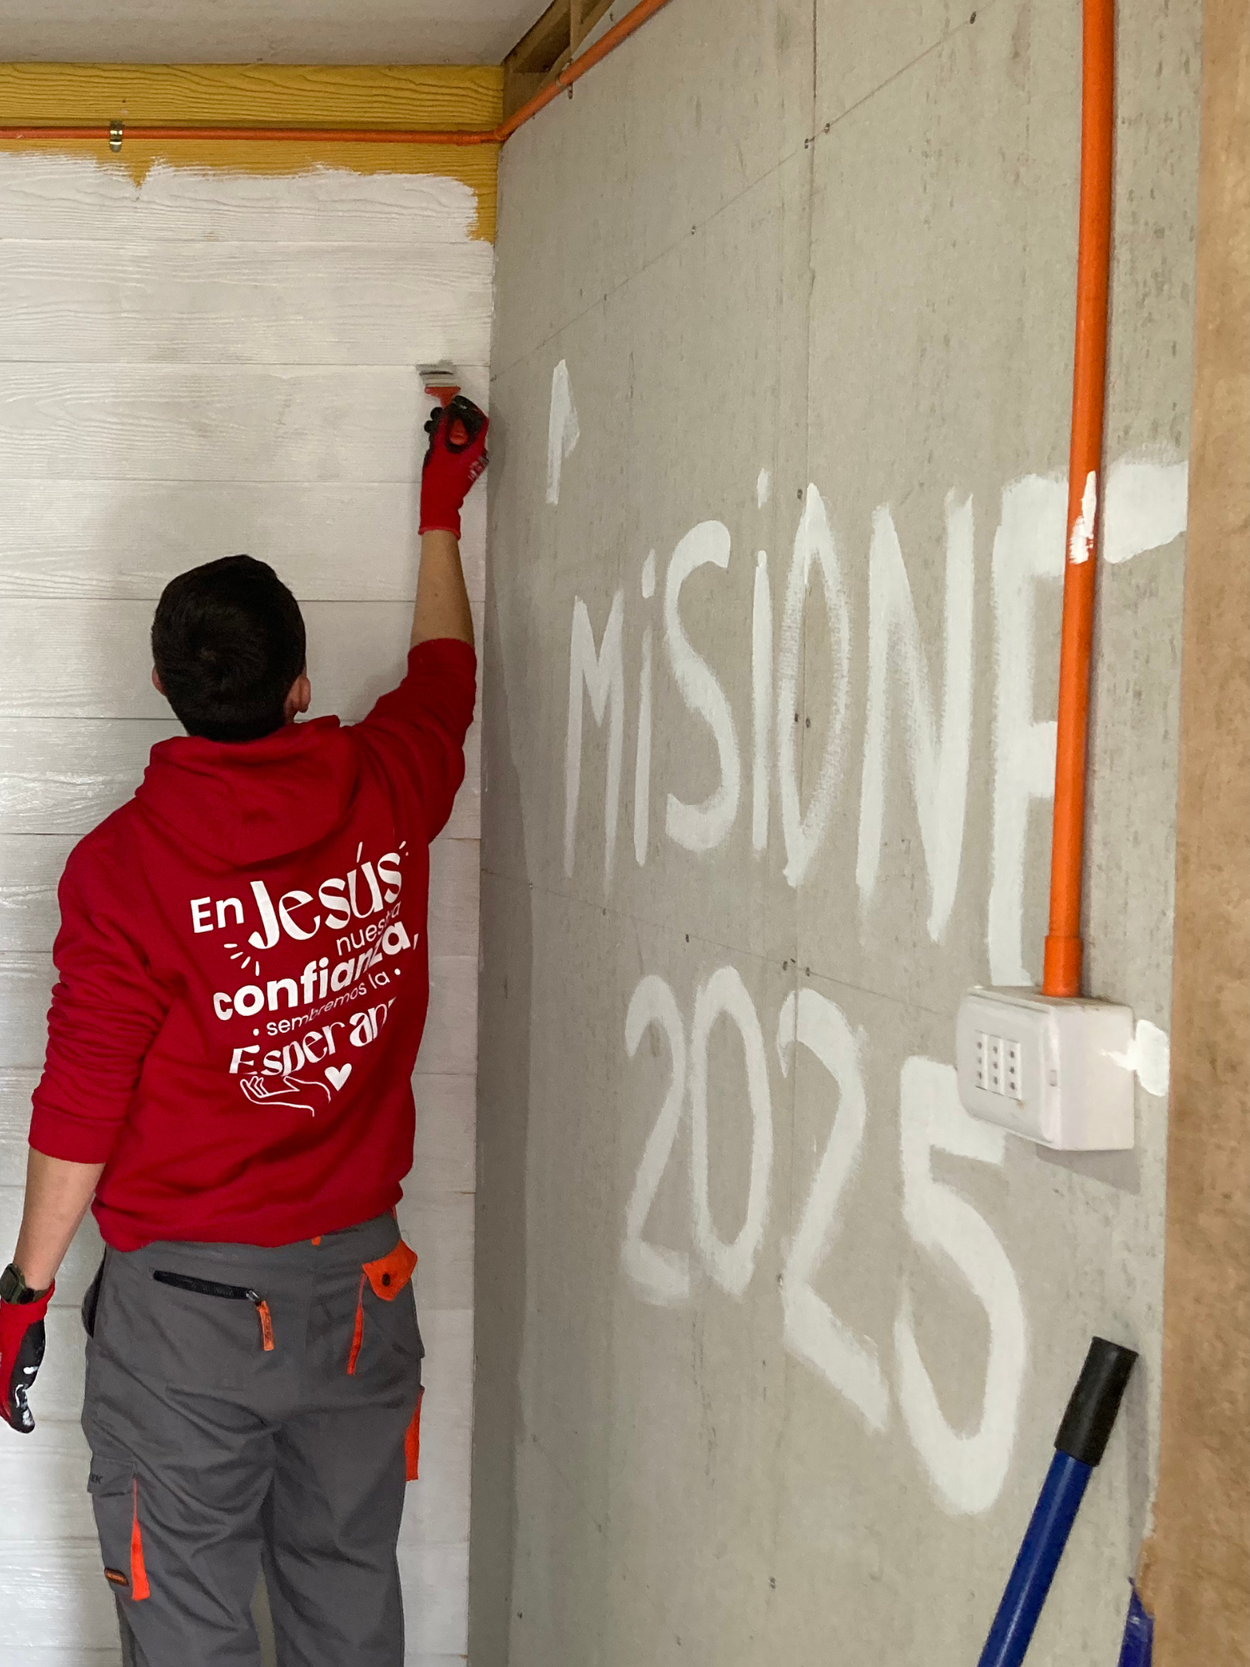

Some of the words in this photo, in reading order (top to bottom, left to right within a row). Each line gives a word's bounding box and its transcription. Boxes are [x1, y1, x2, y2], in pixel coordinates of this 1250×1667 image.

[190, 896, 244, 934] En
[248, 841, 403, 950] Jesús
[336, 901, 401, 956] nuesta
[229, 997, 396, 1077] Esperan
[266, 982, 367, 1036] sembremos
[368, 971, 390, 989] la
[620, 965, 1028, 1514] 2025
